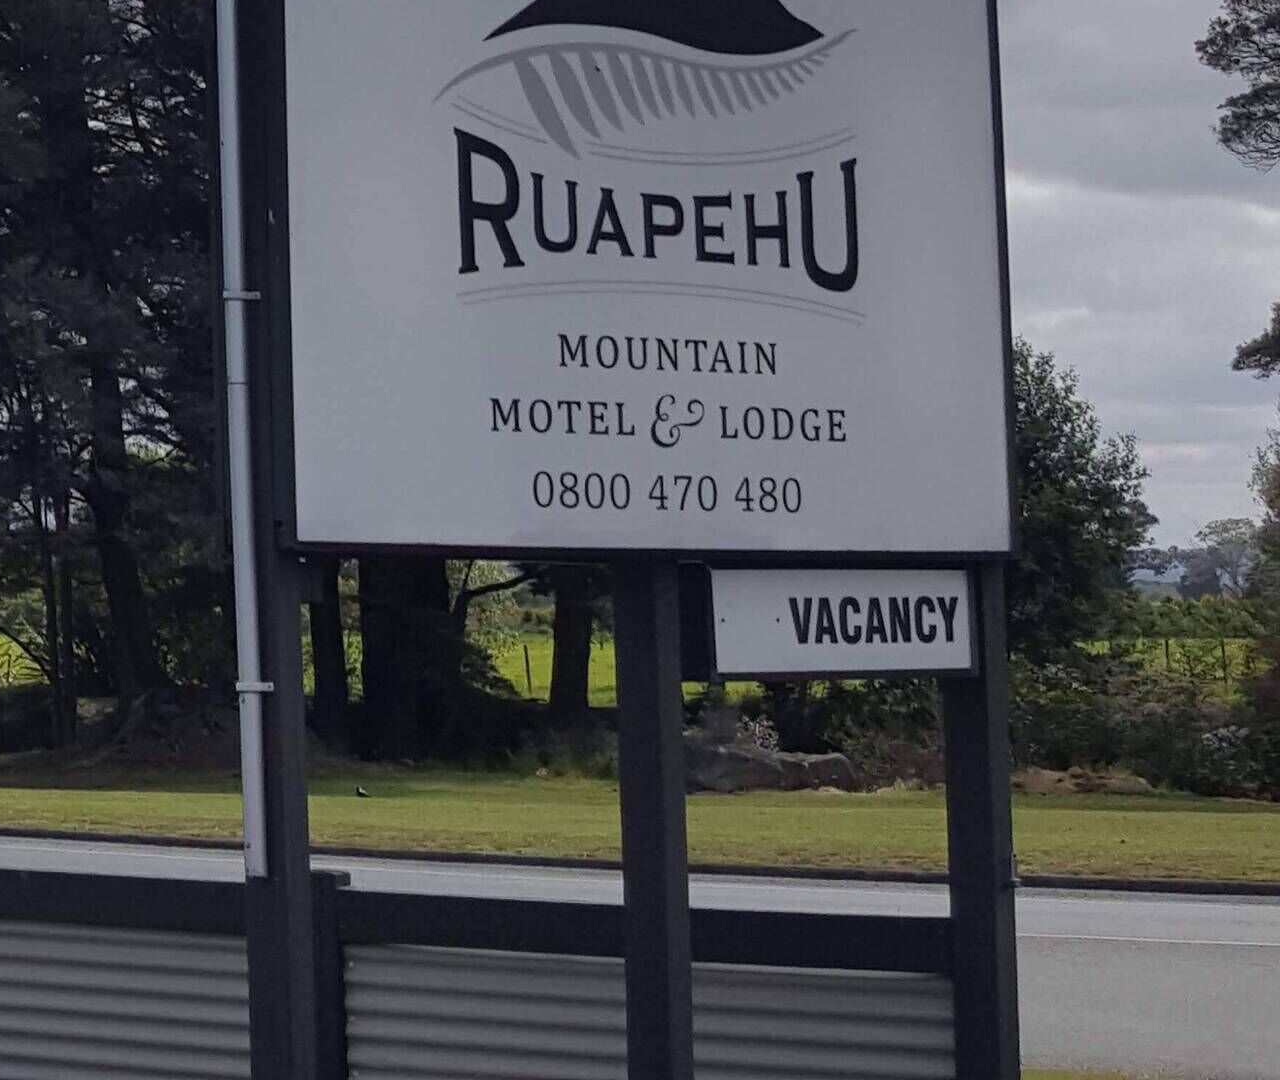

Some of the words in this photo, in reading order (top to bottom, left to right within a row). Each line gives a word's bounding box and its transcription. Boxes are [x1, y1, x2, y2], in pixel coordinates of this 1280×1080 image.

[454, 128, 858, 291] RUAPEHU
[558, 334, 776, 375] MOUNTAIN
[490, 398, 635, 435] MOTEL
[651, 395, 704, 448] &
[720, 406, 846, 442] LODGE
[533, 471, 630, 509] 0800
[649, 475, 717, 511] 470
[735, 477, 801, 513] 480
[789, 596, 958, 644] VACANCY
